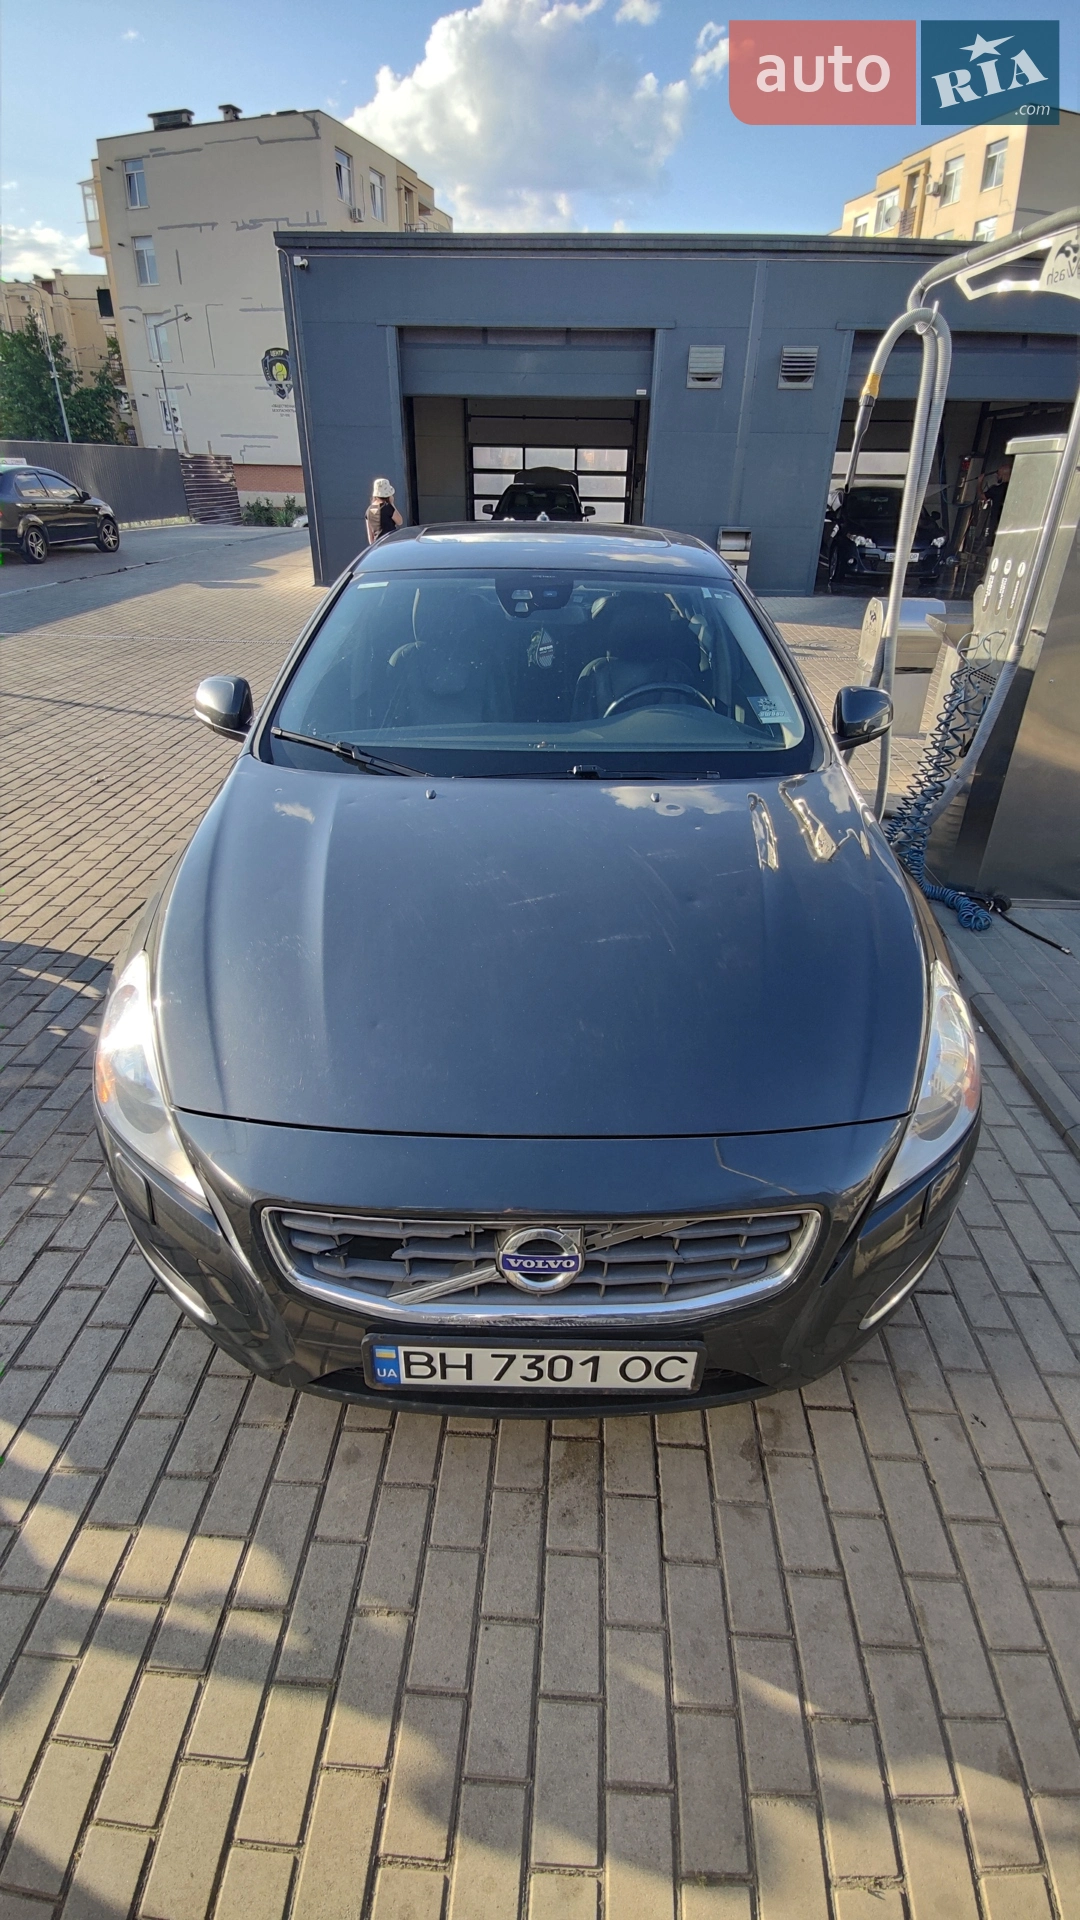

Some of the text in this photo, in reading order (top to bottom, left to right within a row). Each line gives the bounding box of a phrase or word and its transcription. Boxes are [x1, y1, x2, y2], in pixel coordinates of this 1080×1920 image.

[506, 1258, 575, 1269] VOLVO
[376, 1351, 689, 1383] UA BH 7301 OC
